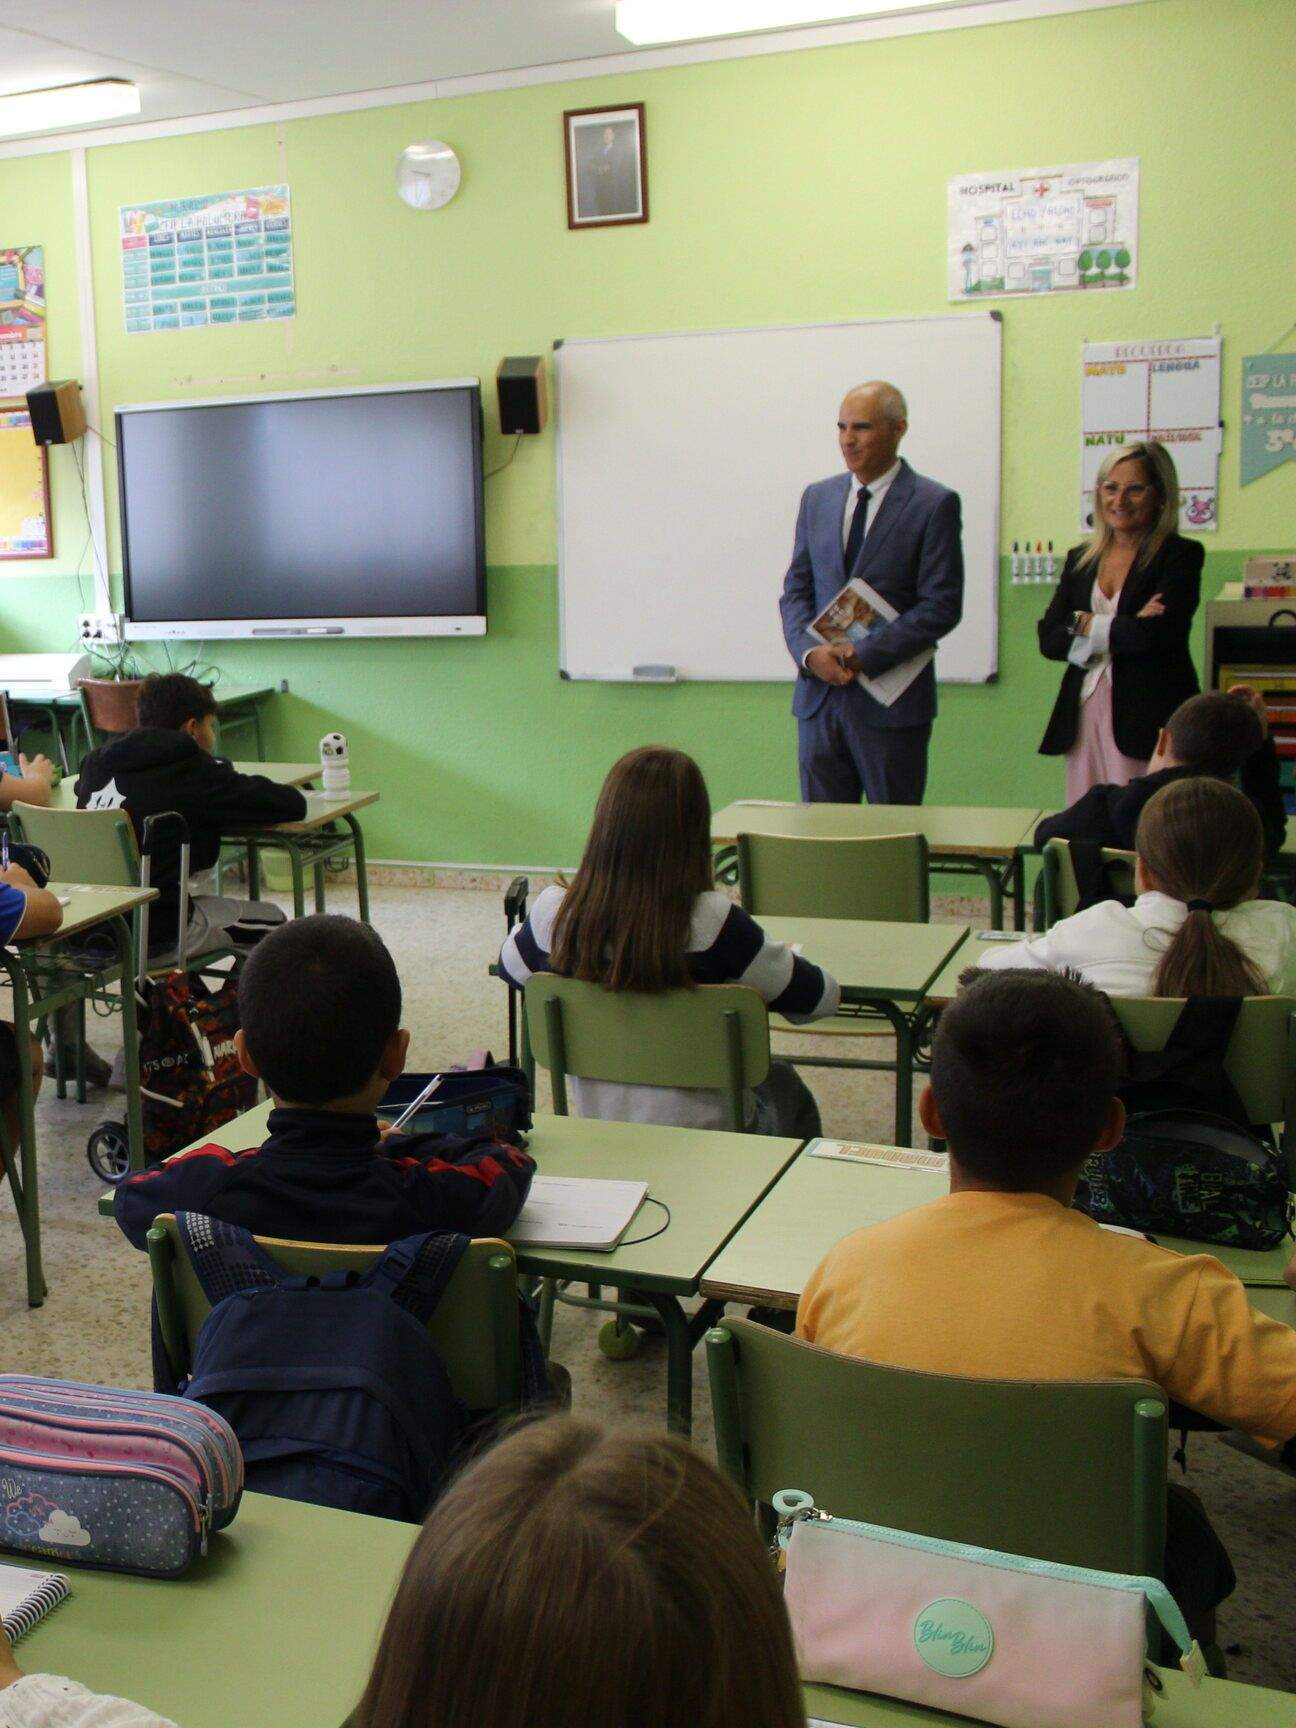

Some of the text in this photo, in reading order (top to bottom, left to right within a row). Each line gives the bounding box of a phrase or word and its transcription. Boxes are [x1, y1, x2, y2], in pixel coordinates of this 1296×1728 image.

[960, 182, 1015, 196] HOSPITAL
[1153, 360, 1200, 373] LENGUA
[1, 1478, 23, 1500] We
